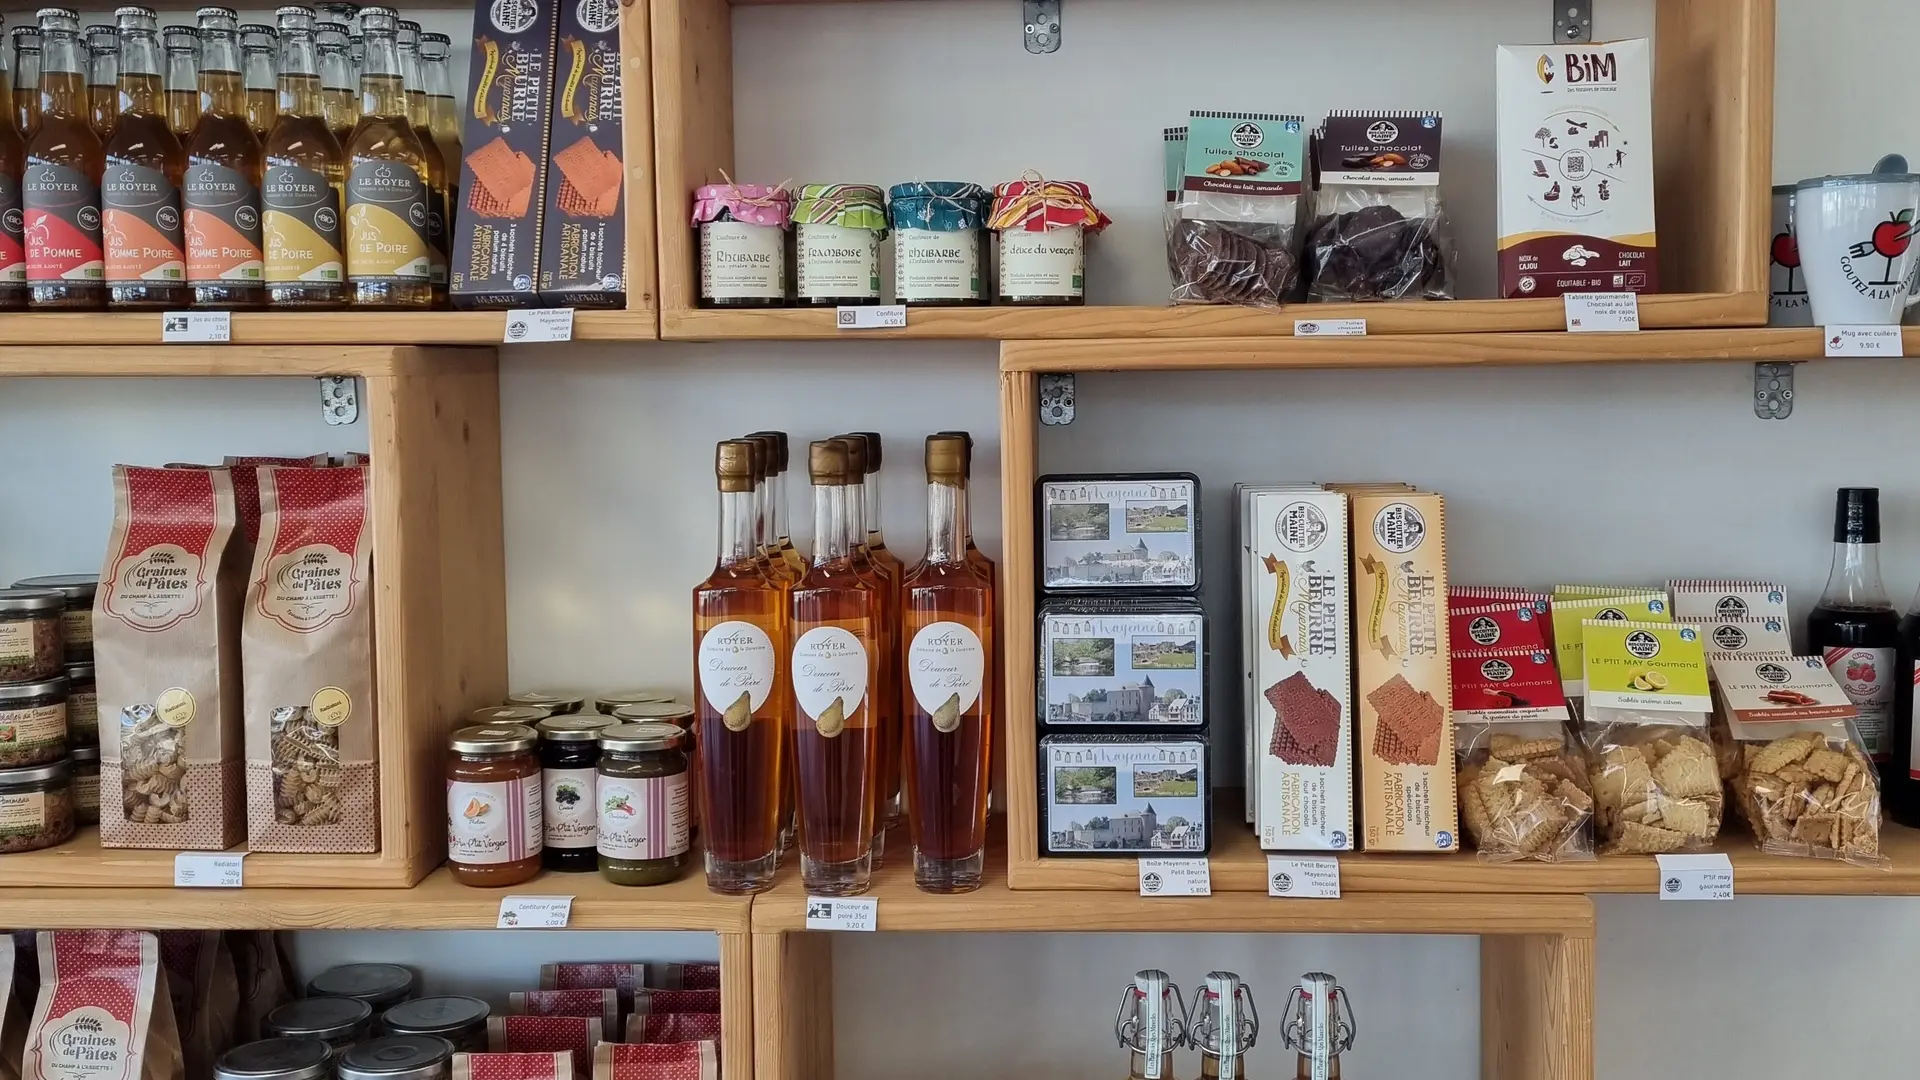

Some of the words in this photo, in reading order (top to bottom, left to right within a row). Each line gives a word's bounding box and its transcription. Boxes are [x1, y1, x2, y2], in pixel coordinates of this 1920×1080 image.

[501, 0, 510, 26] MAINE
[587, 0, 596, 26] MAINE
[530, 53, 542, 73] LE
[1565, 53, 1617, 82] BiM
[495, 49, 521, 123] Mayennais
[512, 53, 529, 122] BEURRE
[598, 53, 616, 121] BEURRE
[526, 76, 541, 121] PETIT
[1204, 148, 1232, 156] Tuiles
[1236, 149, 1284, 158] chocolat
[1340, 144, 1369, 152] Tuiles
[1372, 144, 1422, 152] chocolat
[27, 183, 37, 192] LE
[40, 183, 78, 192] ROYER
[107, 183, 116, 192] LE
[119, 183, 157, 192] ROYER
[187, 183, 196, 192] LE
[198, 183, 235, 192] ROYER
[266, 184, 276, 192] LE
[279, 184, 315, 192] ROYER
[359, 178, 371, 186] LE
[374, 178, 411, 186] ROYER
[1204, 180, 1232, 188] Chocolat
[30, 249, 40, 258] DE
[360, 244, 371, 253] DE
[470, 224, 482, 282] ARTISANALE
[481, 224, 492, 281] FABRICATION
[559, 223, 571, 280] ARTISANALE
[570, 224, 581, 280] FABRICATION
[1034, 244, 1047, 254] du
[1557, 279, 1586, 288] ÉQUITABLE
[1840, 256, 1869, 296] GOUTEZ
[1868, 290, 1876, 299] A
[1878, 289, 1890, 300] LA
[1785, 299, 1798, 308] LA
[1087, 485, 1150, 506] Mayenne
[1289, 510, 1298, 544] MAINE
[1386, 511, 1396, 544] MAINE
[1395, 508, 1403, 548] BISCUITIER
[136, 566, 187, 580] Graines
[291, 567, 341, 580] Graines
[136, 579, 147, 587] de
[147, 578, 188, 590] Pâtes
[292, 581, 303, 589] de
[304, 578, 342, 590] Pâtes
[1322, 575, 1335, 597] LE
[1421, 575, 1435, 597] LE
[1308, 575, 1322, 656] BEURRE
[1407, 575, 1422, 656] BEURRE
[1092, 618, 1158, 638] Mayenne
[1323, 602, 1336, 655] PETIT
[1422, 602, 1437, 655] PETIT
[709, 658, 748, 672] Douceur
[802, 663, 840, 677] Douceur
[919, 658, 958, 672] Douceur
[1647, 660, 1698, 669] Gourmand
[720, 678, 730, 686] de
[734, 672, 762, 686] Poiré
[813, 684, 823, 692] de
[827, 678, 854, 692] Poiré
[929, 680, 940, 688] de
[944, 673, 971, 688] Poiré
[1503, 679, 1553, 688] Gourmand
[1093, 747, 1159, 767] Mayenne
[1281, 772, 1291, 836] ARTISANALE
[1291, 772, 1300, 835] FABRICATION
[1384, 772, 1394, 836] ARTISANALE
[1393, 772, 1404, 835] FABRICATION
[224, 870, 240, 878] 400g
[61, 1033, 117, 1046] Graines
[63, 1047, 75, 1056] de
[75, 1047, 118, 1061] Pâtes
